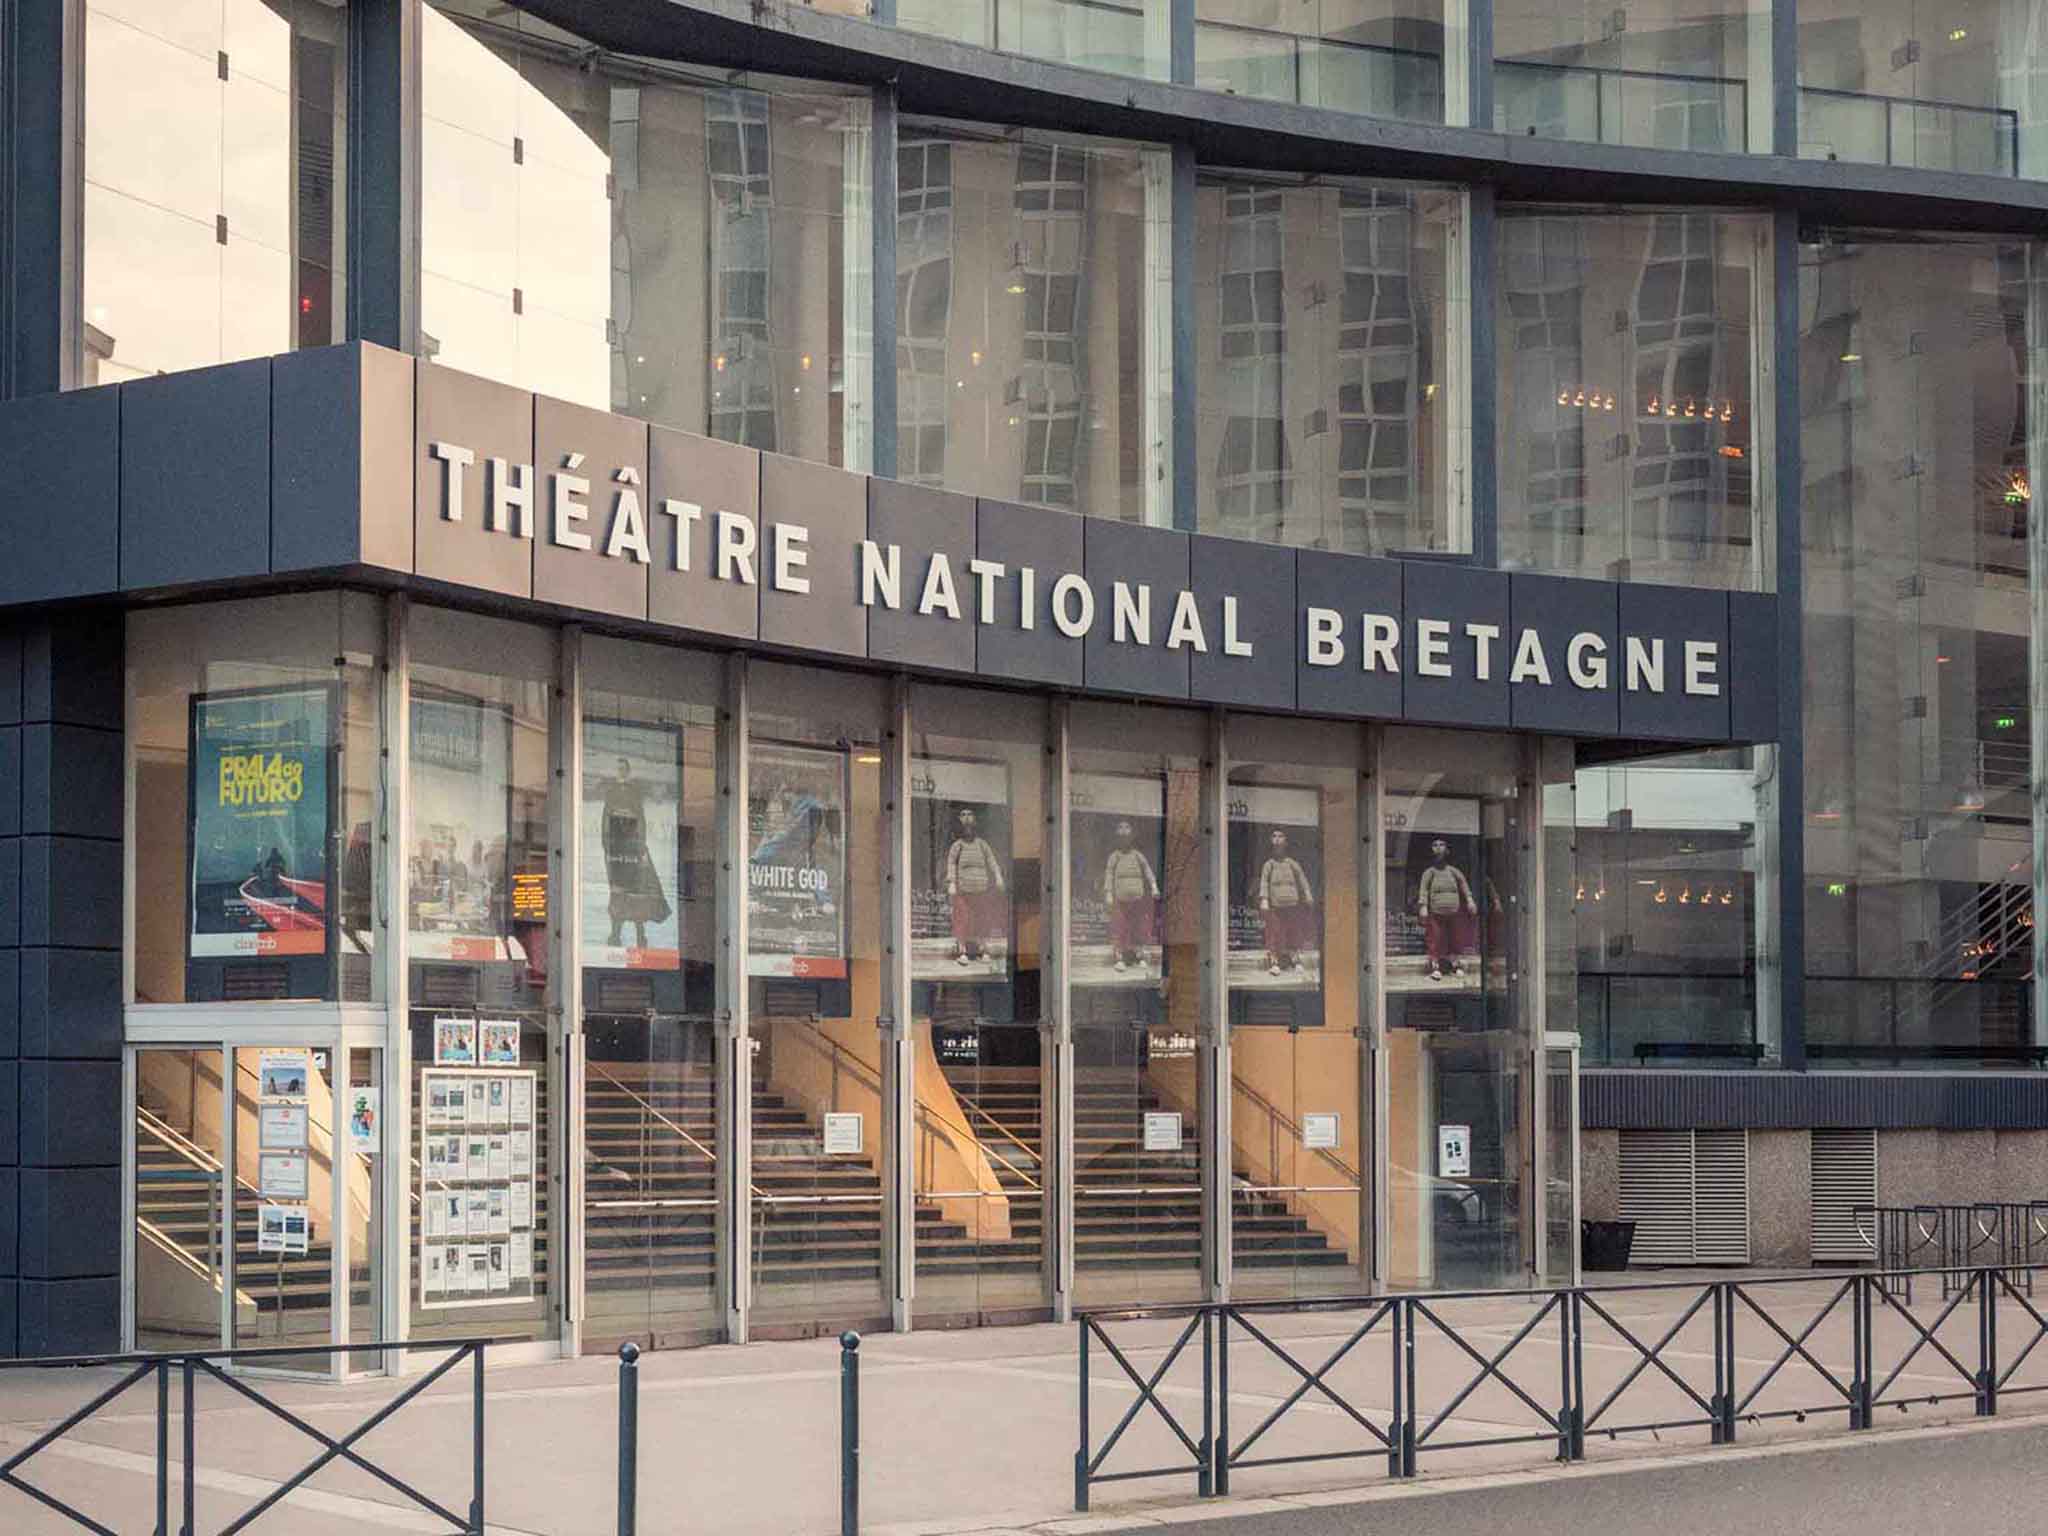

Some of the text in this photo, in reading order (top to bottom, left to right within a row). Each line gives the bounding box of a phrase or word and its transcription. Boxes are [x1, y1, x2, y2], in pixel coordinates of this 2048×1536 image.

[431, 441, 1721, 696] THÉÂTRE NATIONAL BRETAGNE
[218, 776, 304, 808] FUTURO
[750, 864, 828, 891] WHITE GOD
